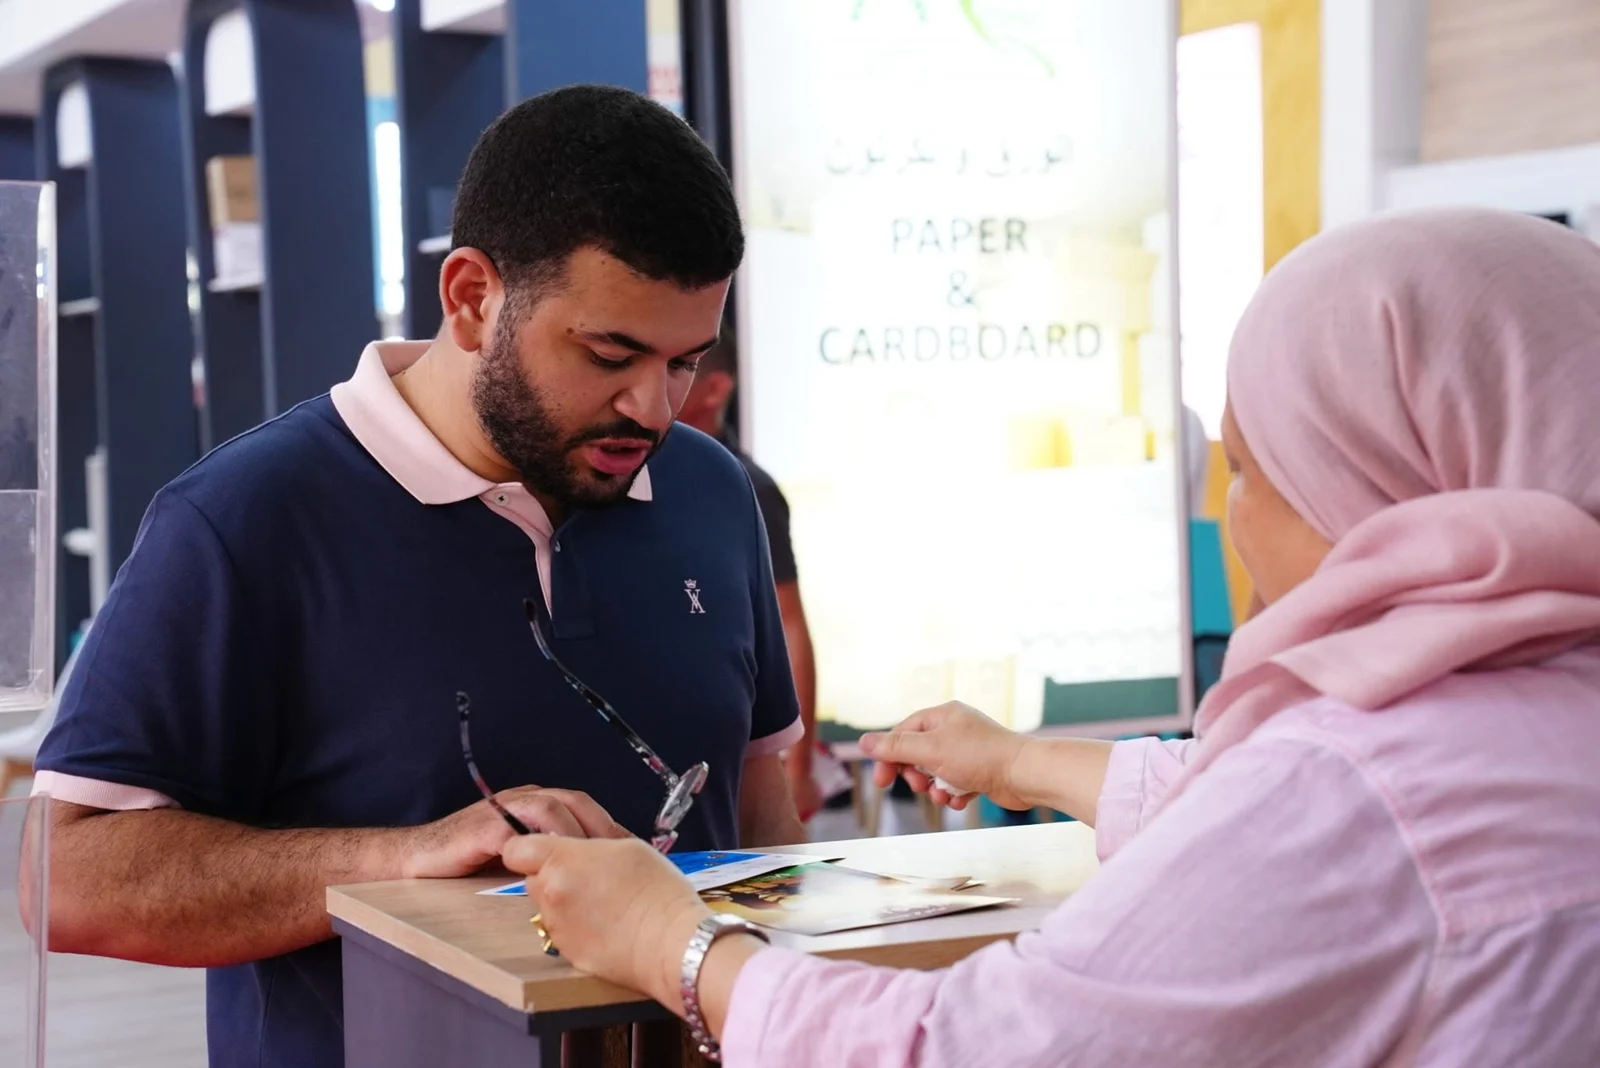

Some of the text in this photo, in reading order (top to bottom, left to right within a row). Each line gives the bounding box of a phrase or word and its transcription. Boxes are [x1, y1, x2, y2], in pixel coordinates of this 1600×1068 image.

[890, 216, 1029, 255] PAPER
[946, 269, 979, 309] &
[818, 321, 1103, 366] CARDBOARD
